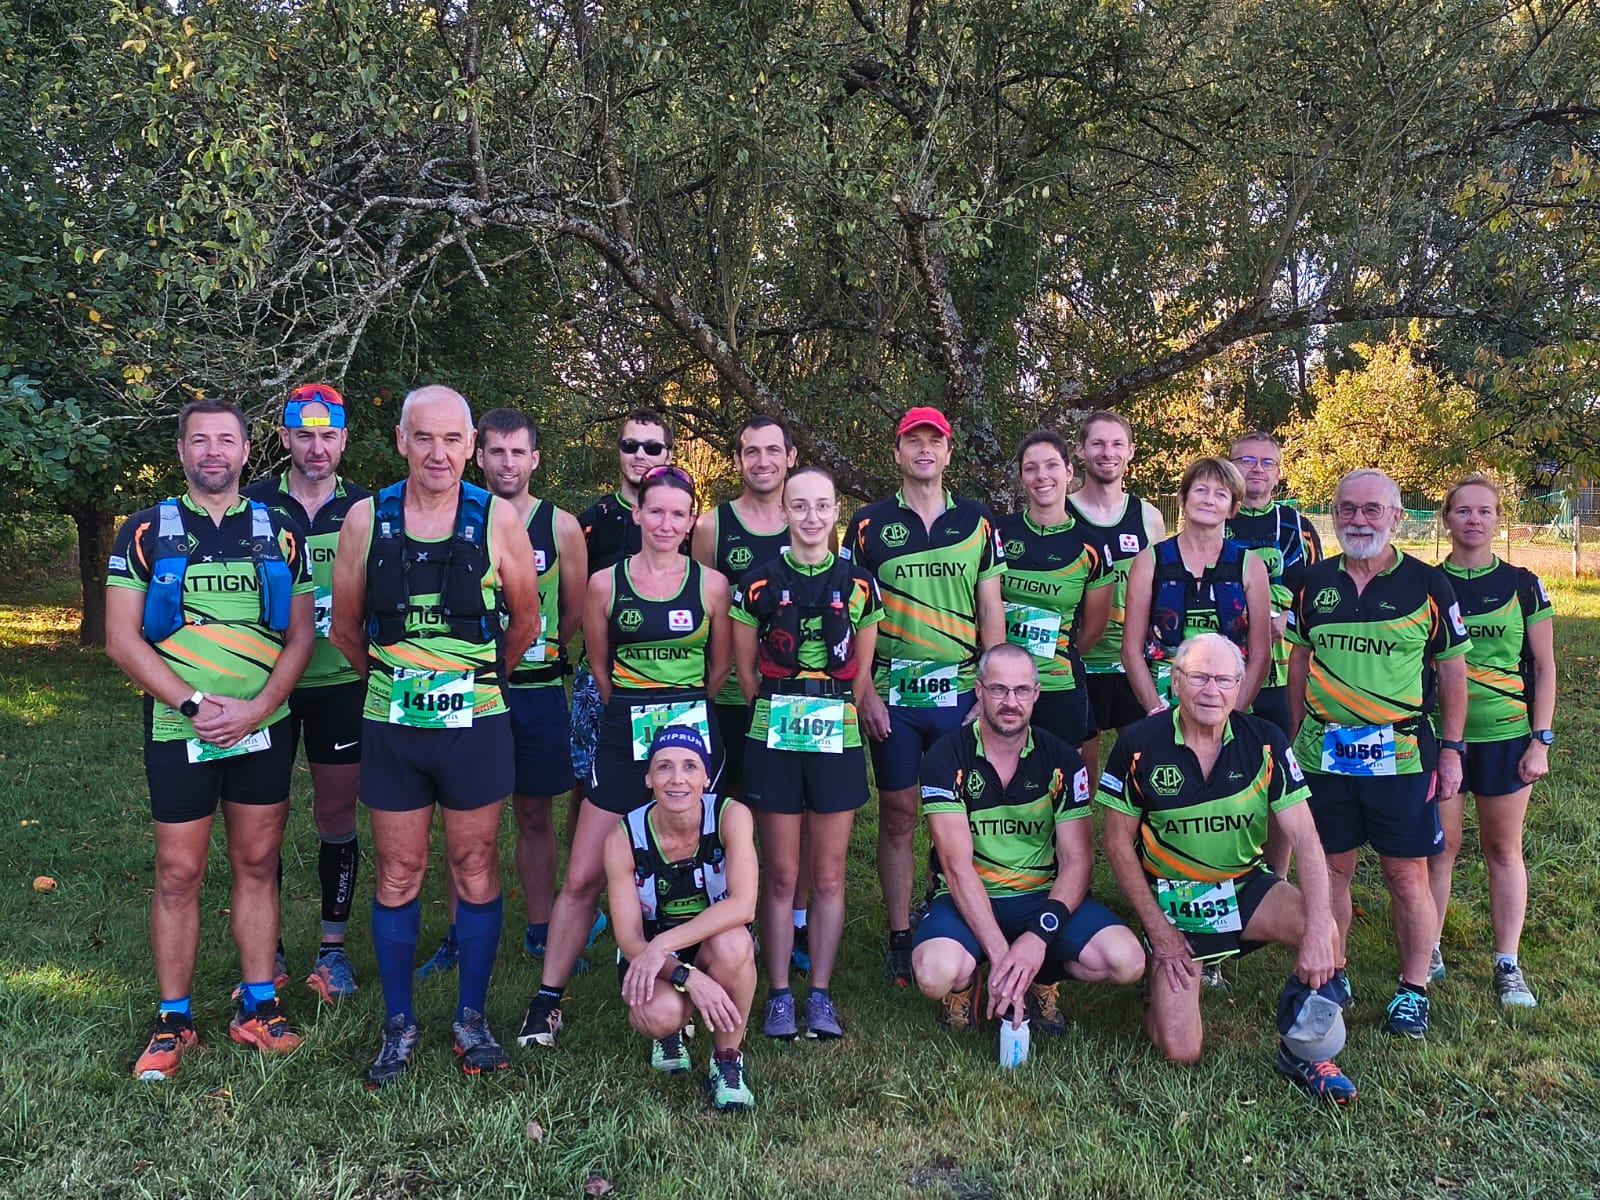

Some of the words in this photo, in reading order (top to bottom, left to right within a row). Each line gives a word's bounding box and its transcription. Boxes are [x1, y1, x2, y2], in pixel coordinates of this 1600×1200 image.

[894, 562, 967, 579] ATTIGNY
[182, 574, 258, 593] TTIGN
[1000, 574, 1063, 596] ATTIGNY
[1005, 620, 1051, 643] 14155
[625, 647, 692, 660] ATTIGNY
[1318, 633, 1397, 657] ATTIGNY
[900, 678, 950, 693] 14168
[403, 691, 464, 711] 14180
[780, 716, 835, 737] 14167
[659, 733, 702, 747] KIPRUN
[1335, 742, 1383, 760] 9056
[970, 818, 1045, 836] ATTIGNY
[1164, 813, 1255, 834] ATTIGNY
[1169, 898, 1230, 919] 14133
